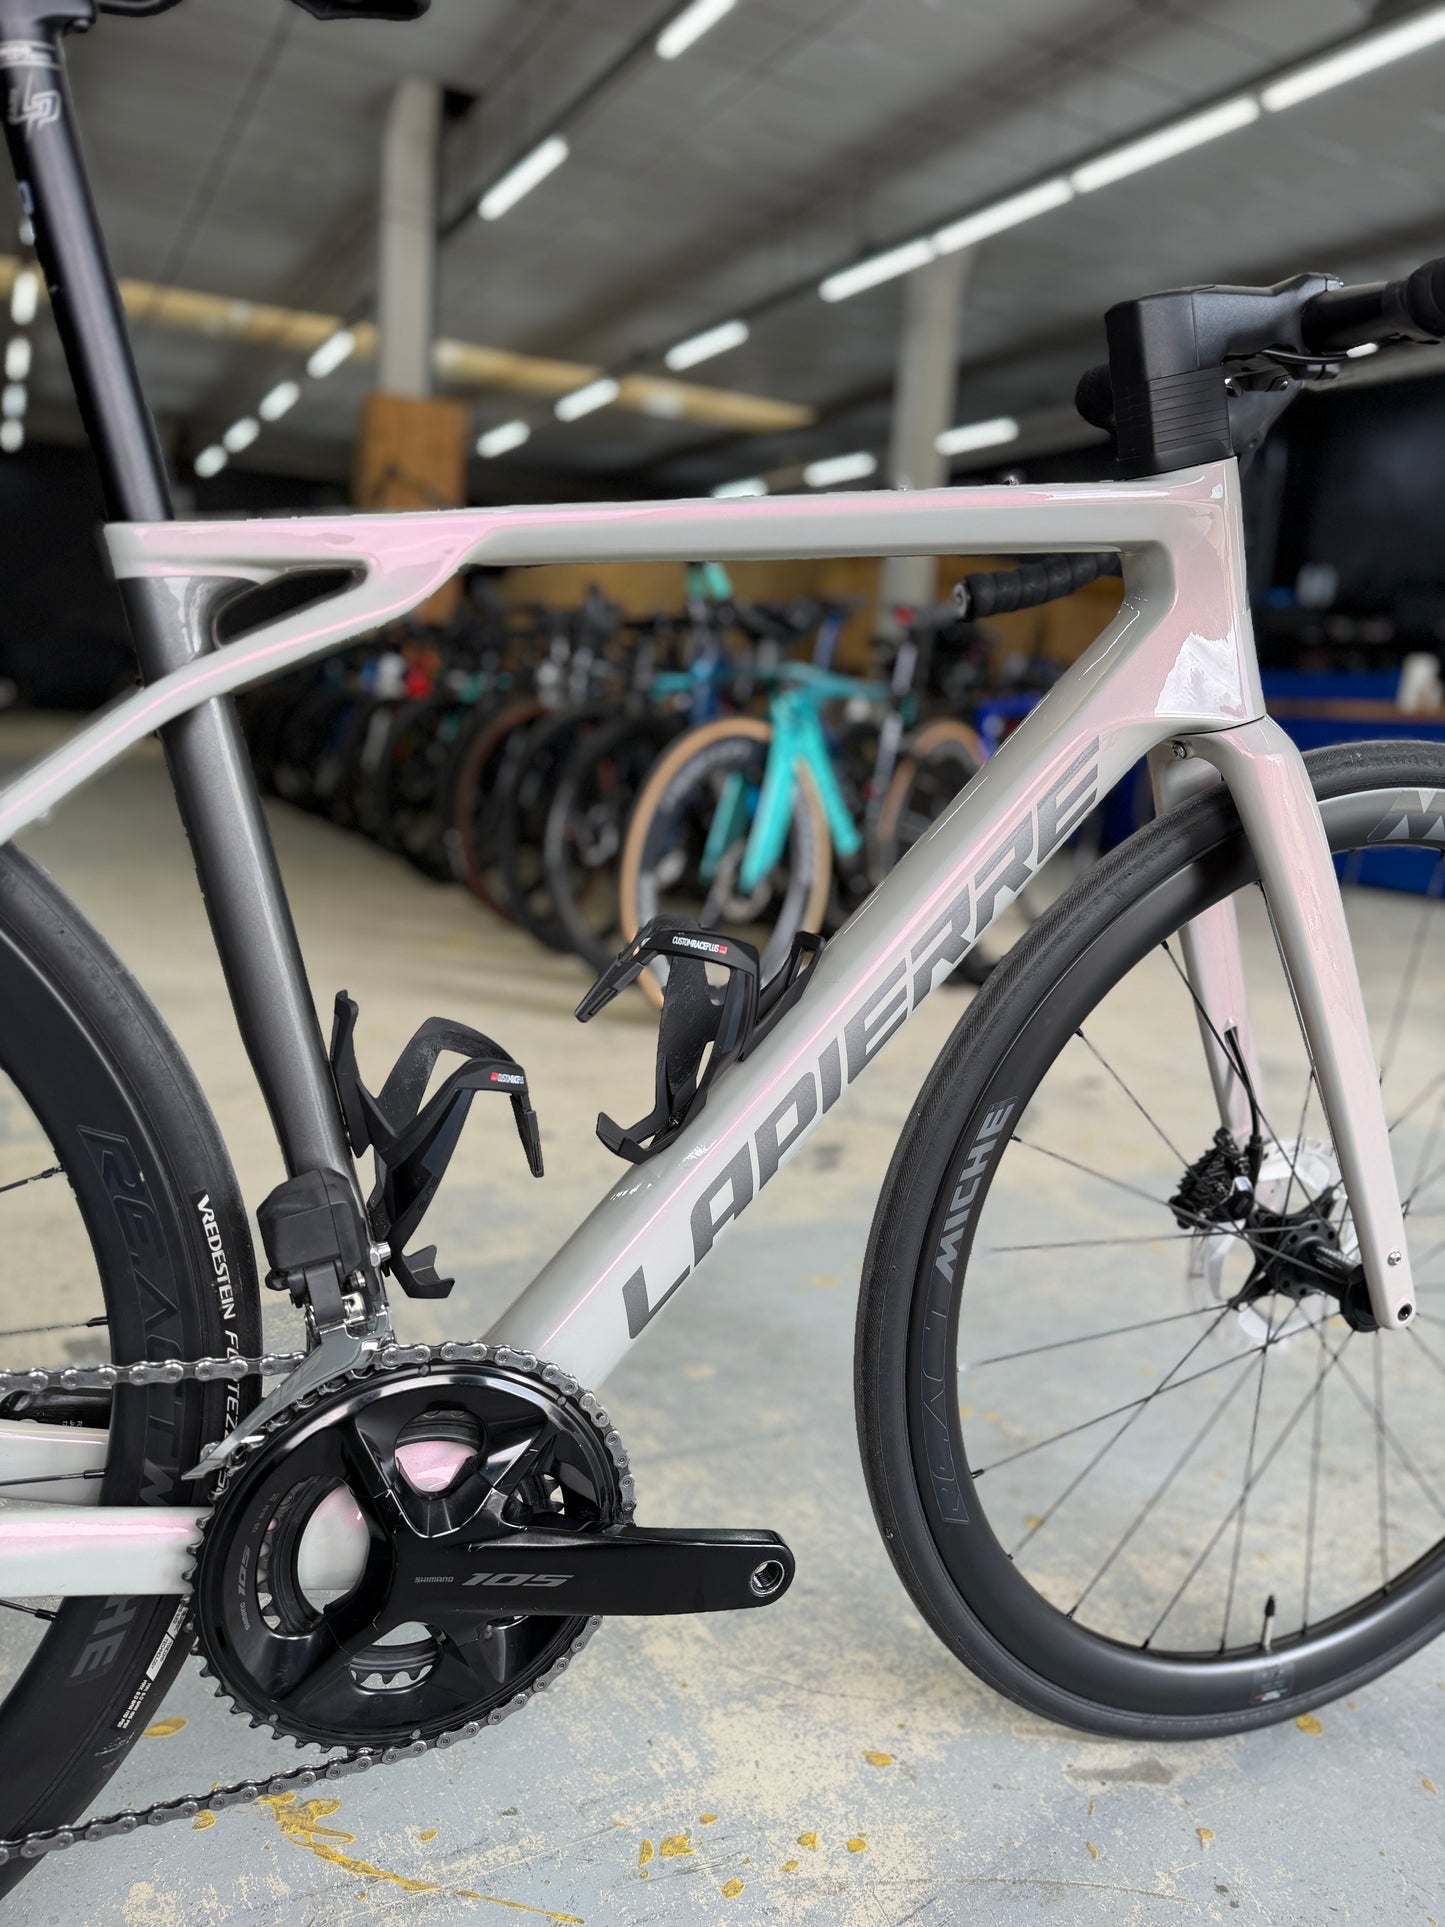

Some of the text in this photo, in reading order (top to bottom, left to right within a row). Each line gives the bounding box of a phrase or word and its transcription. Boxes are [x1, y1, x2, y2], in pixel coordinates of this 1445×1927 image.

[622, 735, 1099, 1339] LAPIERRE
[197, 1194, 236, 1320] VREDESTEIN
[935, 1103, 1015, 1285] MICHE
[238, 1544, 251, 1596] 105
[461, 1573, 575, 1587] 105
